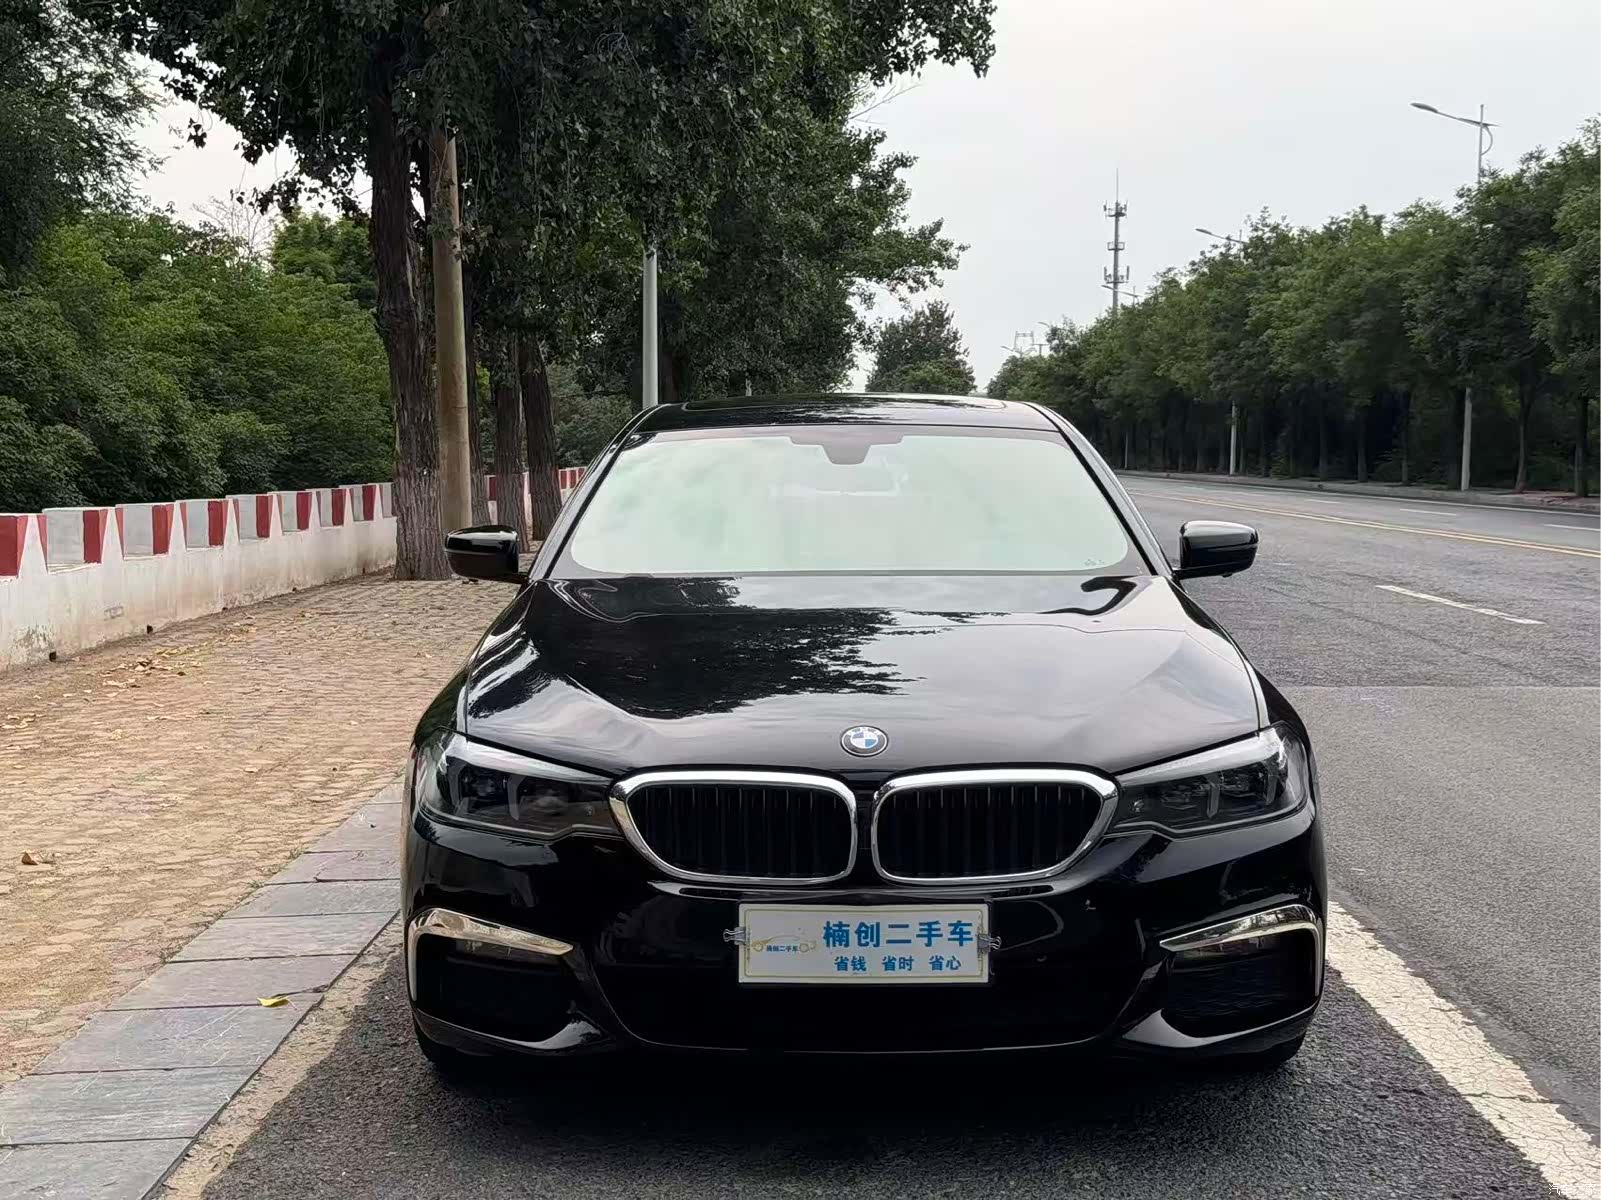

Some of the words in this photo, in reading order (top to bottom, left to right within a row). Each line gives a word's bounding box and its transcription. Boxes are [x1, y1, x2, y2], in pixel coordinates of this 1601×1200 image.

[823, 920, 973, 947] 楠创二手车
[834, 956, 867, 972] 省钱
[881, 956, 914, 971] 省时
[929, 955, 961, 971] 省心
